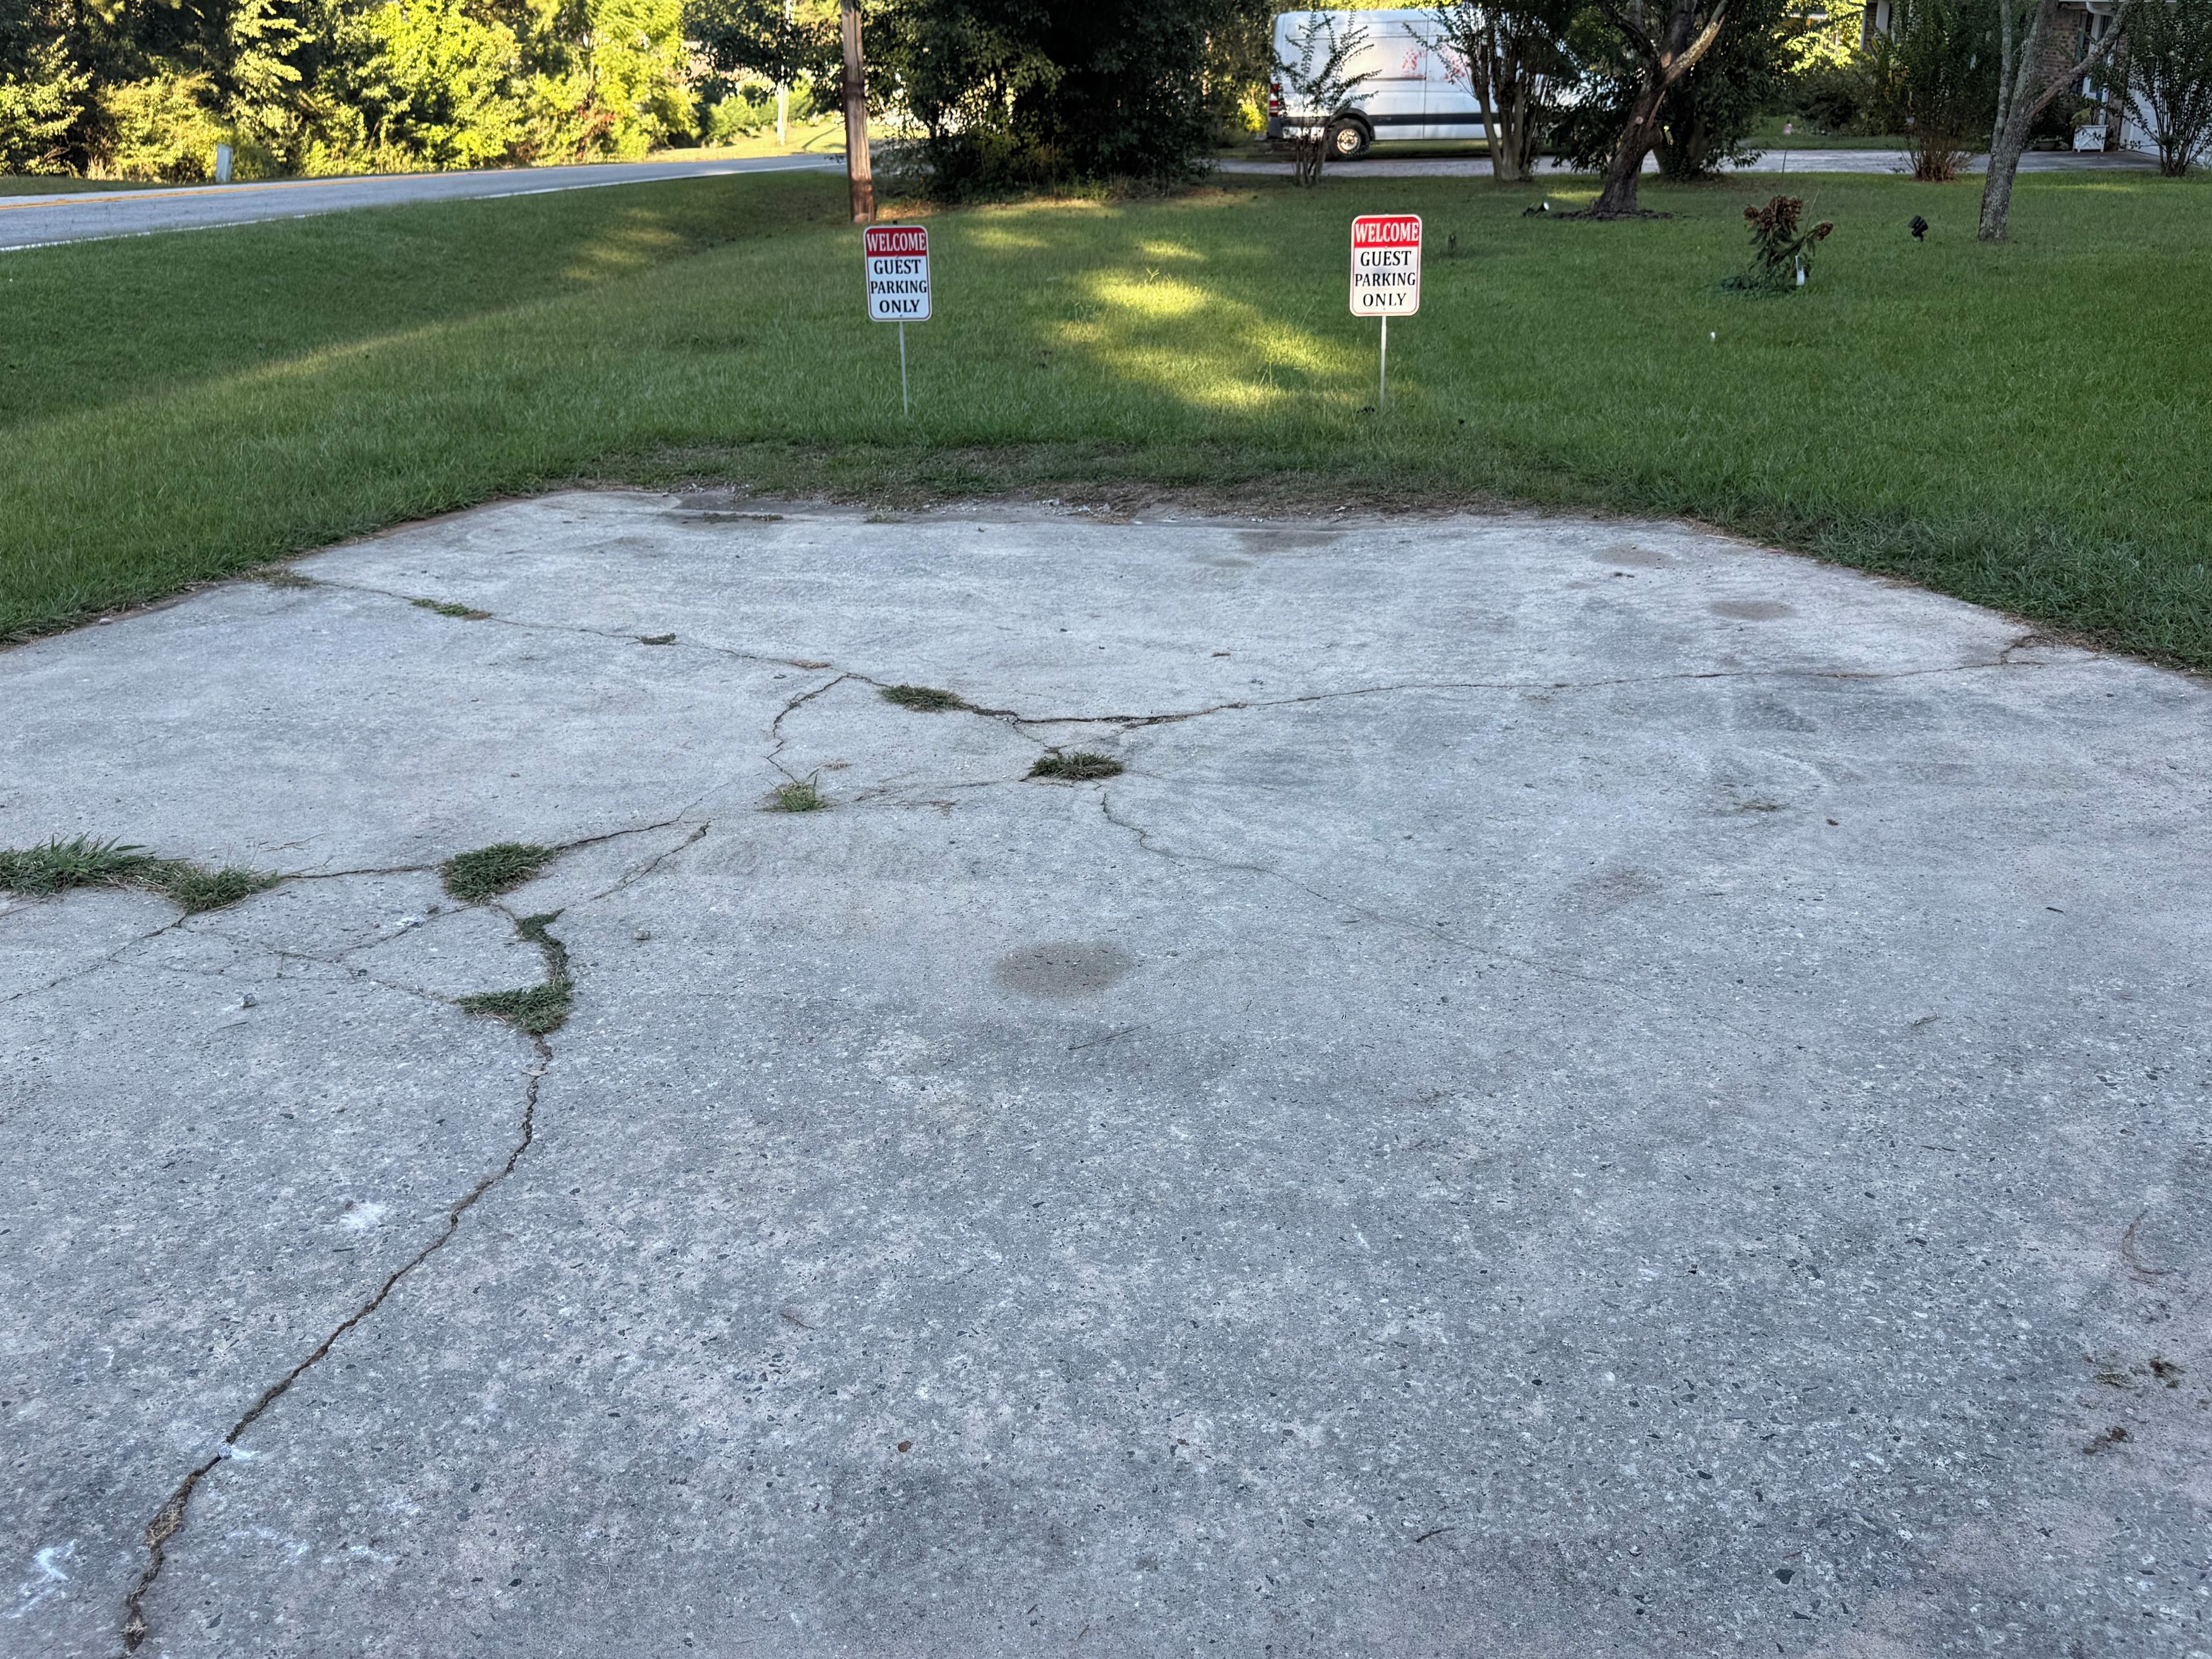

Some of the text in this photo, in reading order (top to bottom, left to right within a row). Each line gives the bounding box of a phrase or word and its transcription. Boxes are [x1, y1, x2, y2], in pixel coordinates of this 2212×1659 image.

[1355, 222, 1419, 243] WELCOME
[866, 233, 926, 252] WELCOME
[1361, 251, 1411, 266] GUEST
[874, 259, 921, 274] GUEST
[870, 280, 927, 294] PARKING
[1355, 272, 1415, 287] PARKING
[879, 300, 920, 313] ONLY
[1363, 293, 1407, 306] ONLY
